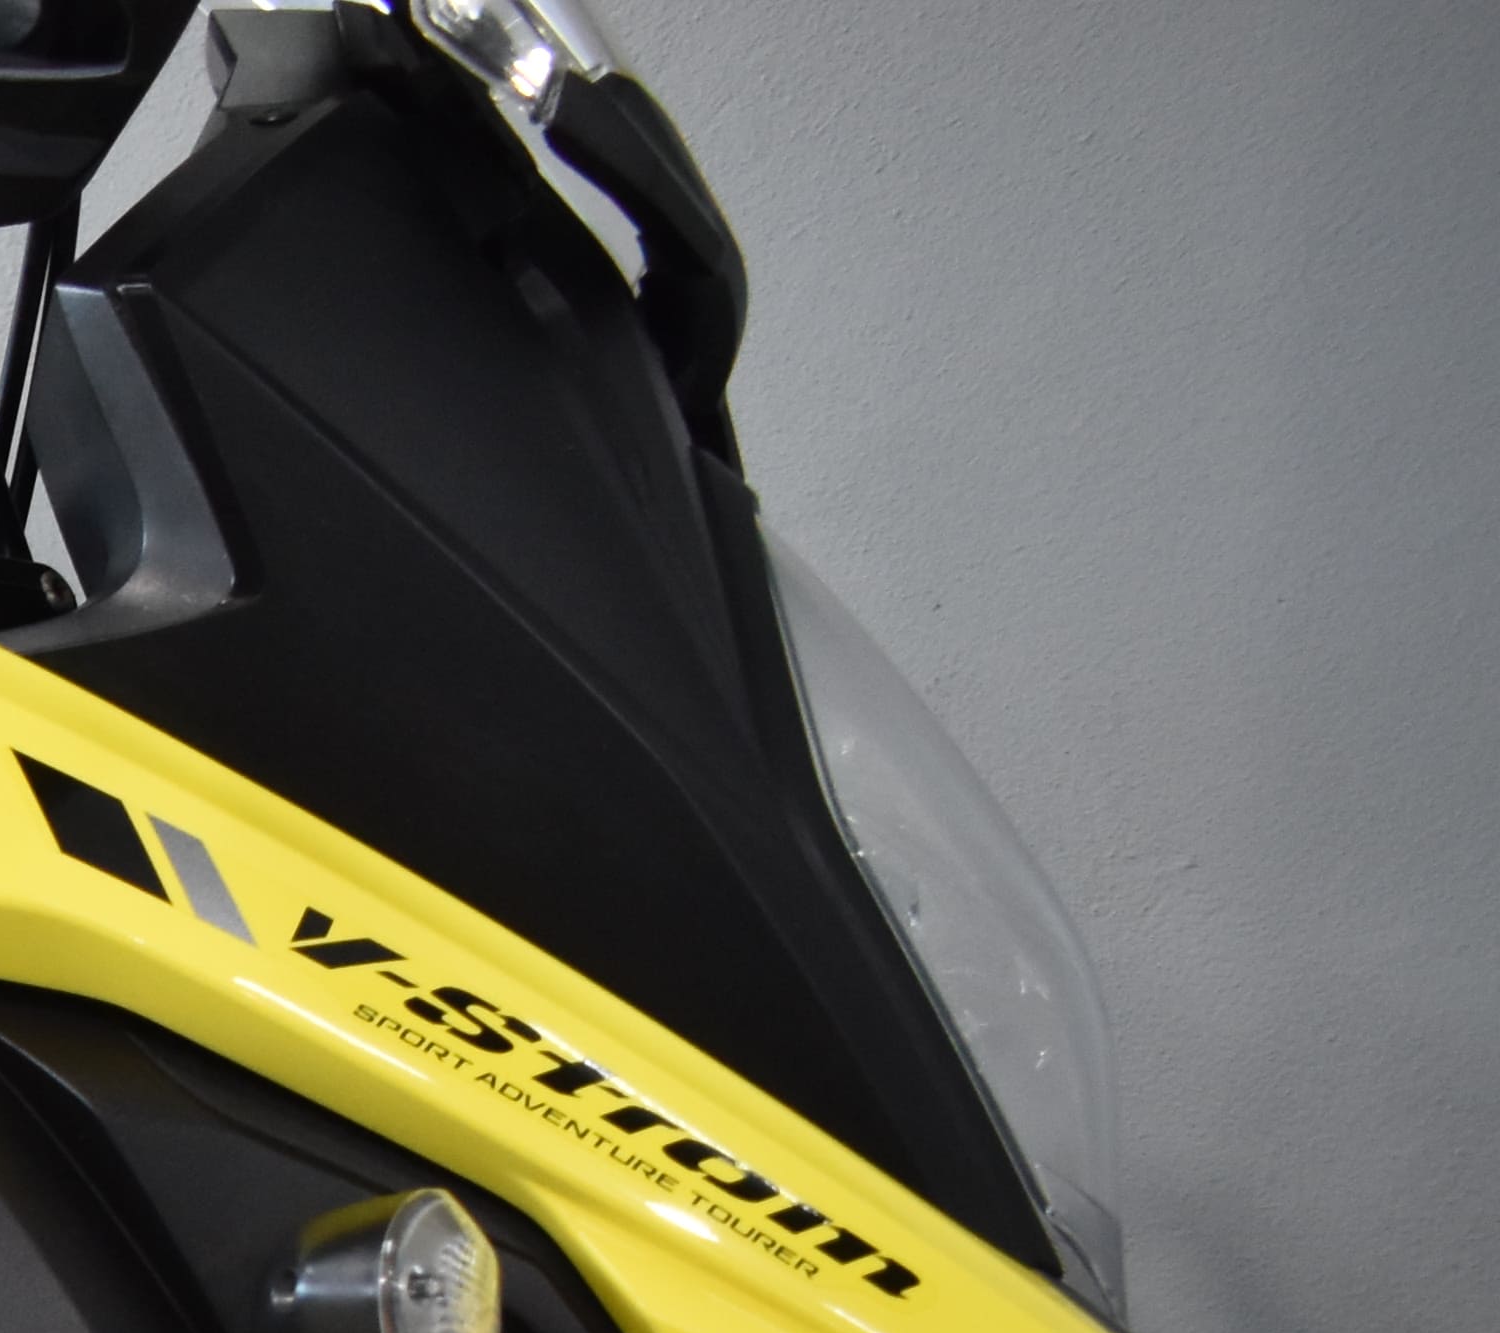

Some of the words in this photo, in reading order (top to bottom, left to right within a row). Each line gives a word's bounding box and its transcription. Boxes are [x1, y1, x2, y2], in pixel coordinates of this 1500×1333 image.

[289, 905, 923, 1302] V-Strom
[352, 1001, 475, 1073] SPORT
[475, 1071, 684, 1196] ADVENTURE
[681, 1186, 822, 1282] TOURER
